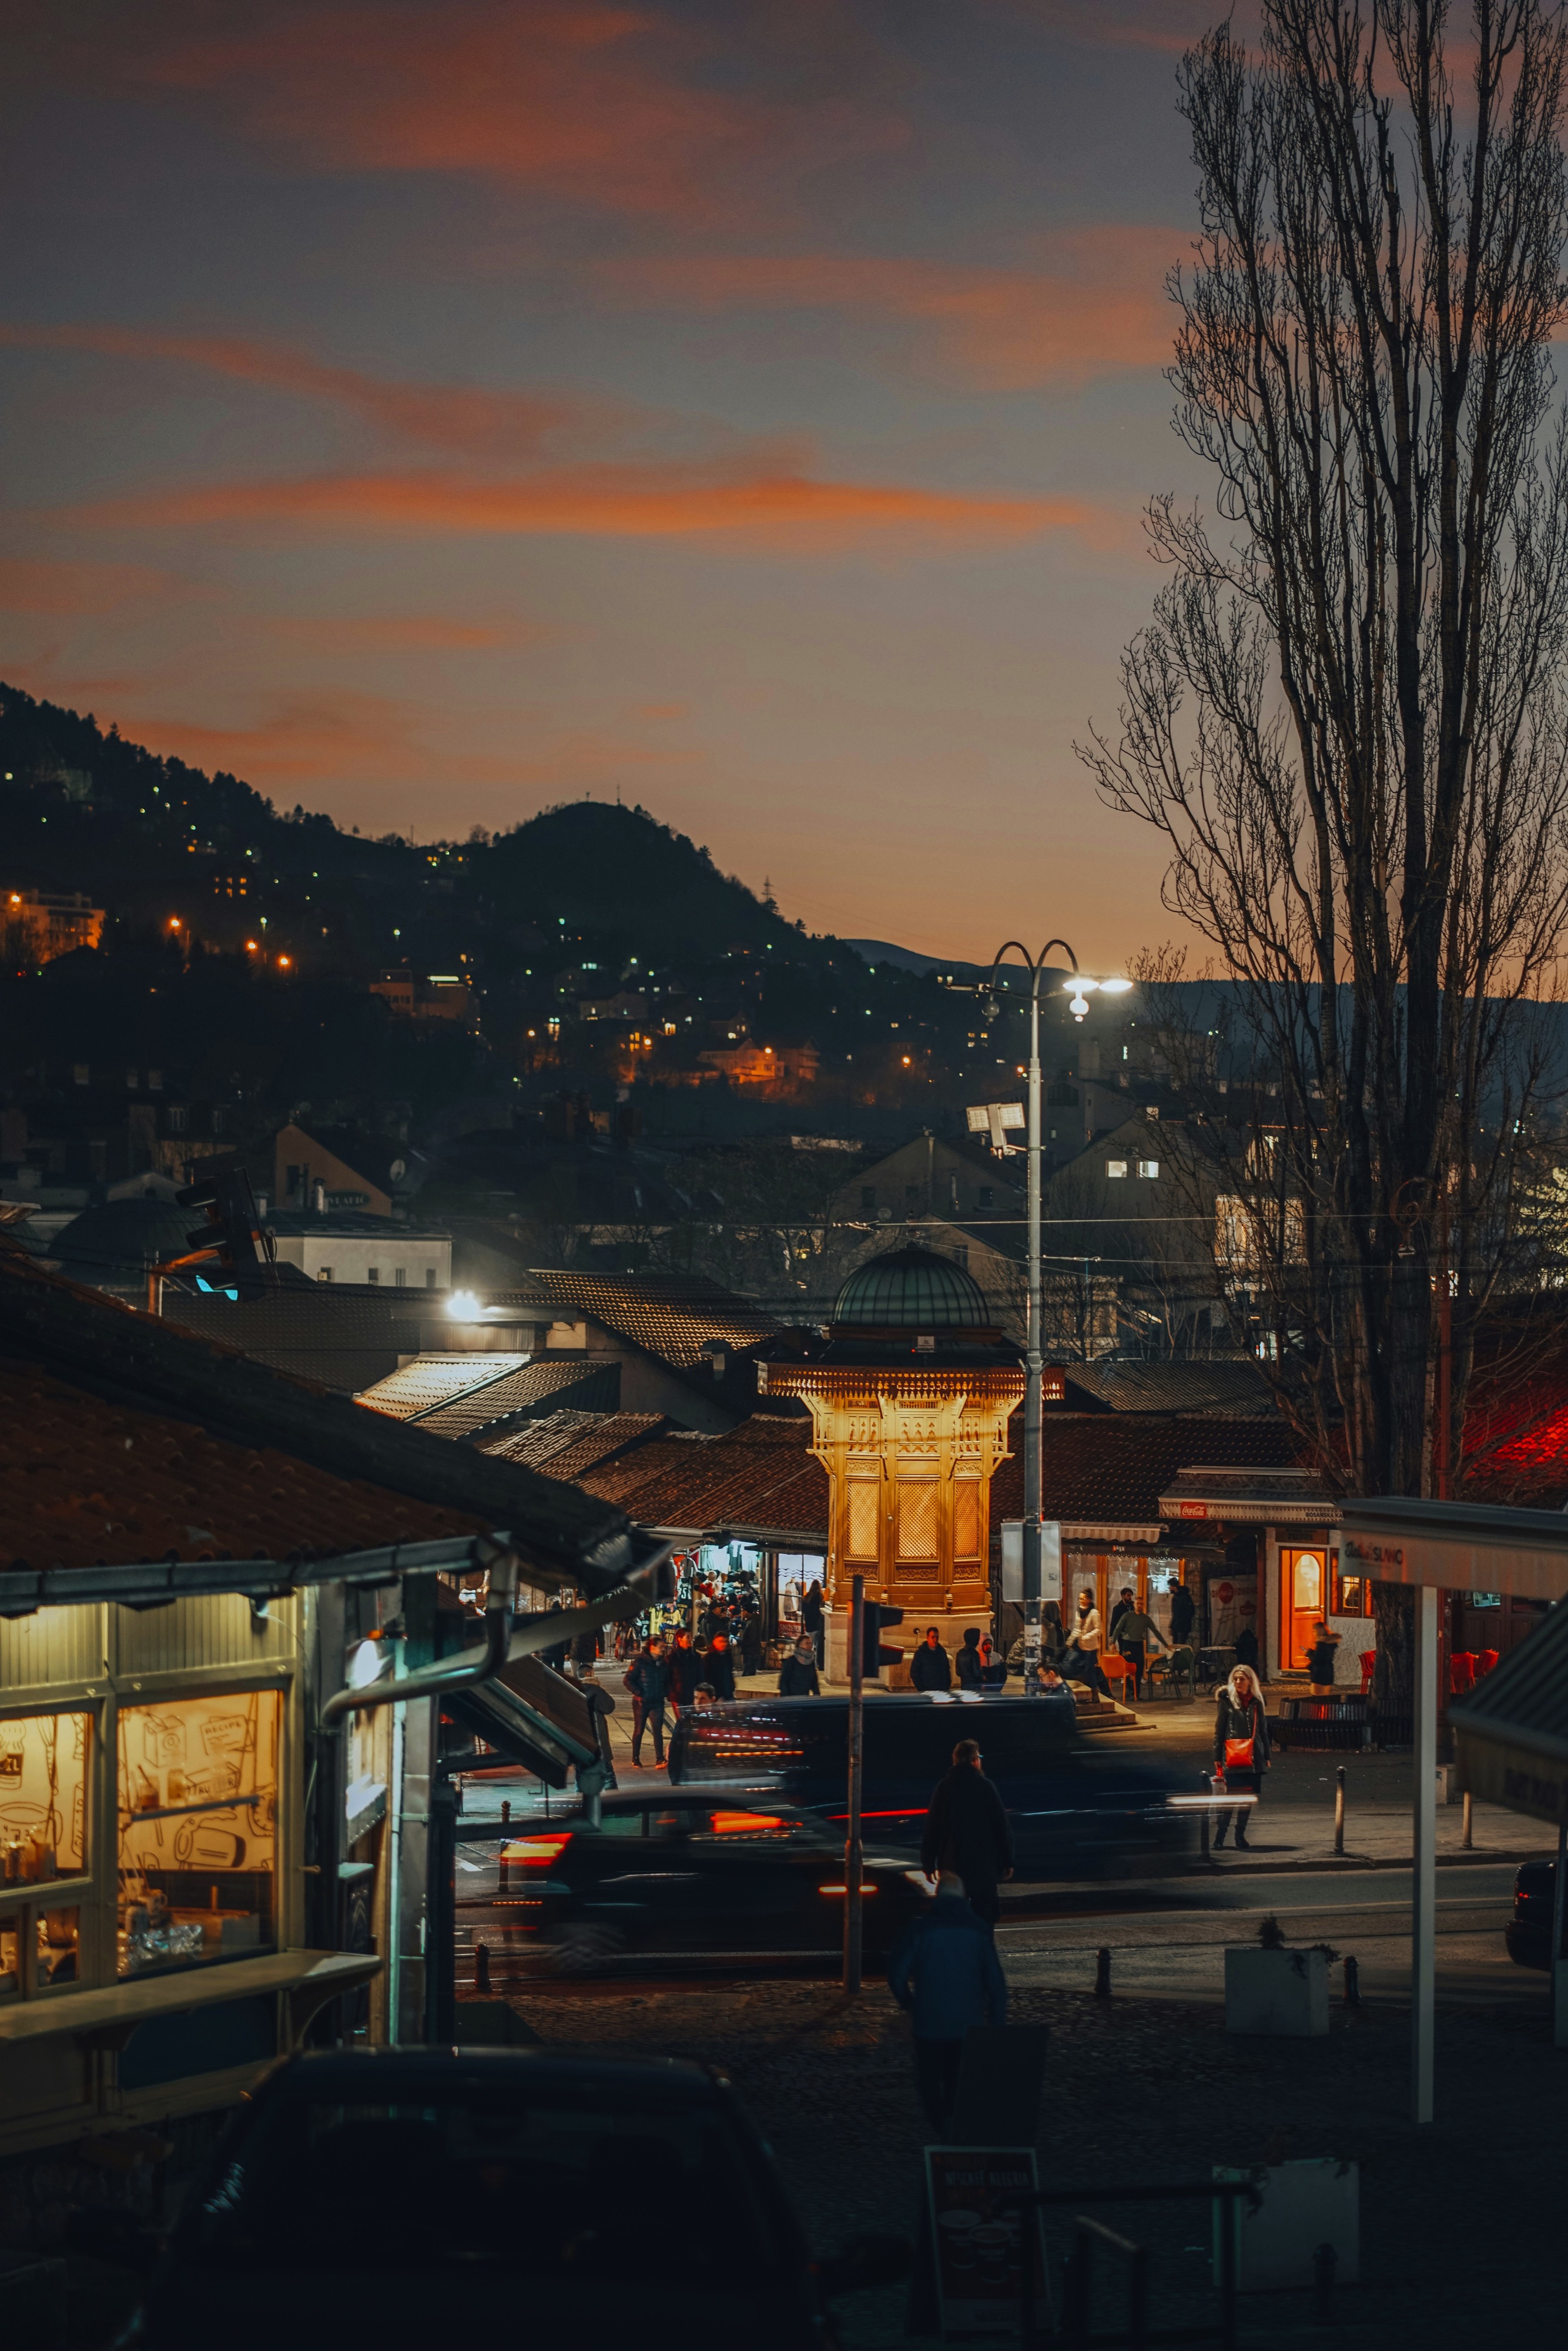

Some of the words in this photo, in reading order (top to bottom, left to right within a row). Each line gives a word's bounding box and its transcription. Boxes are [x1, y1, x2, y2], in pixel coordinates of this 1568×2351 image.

[1182, 1506, 1204, 1516] Coca-Cola
[641, 1625, 648, 1637] 6
[665, 1633, 674, 1643] 10
[205, 1721, 242, 1734] RECIPE
